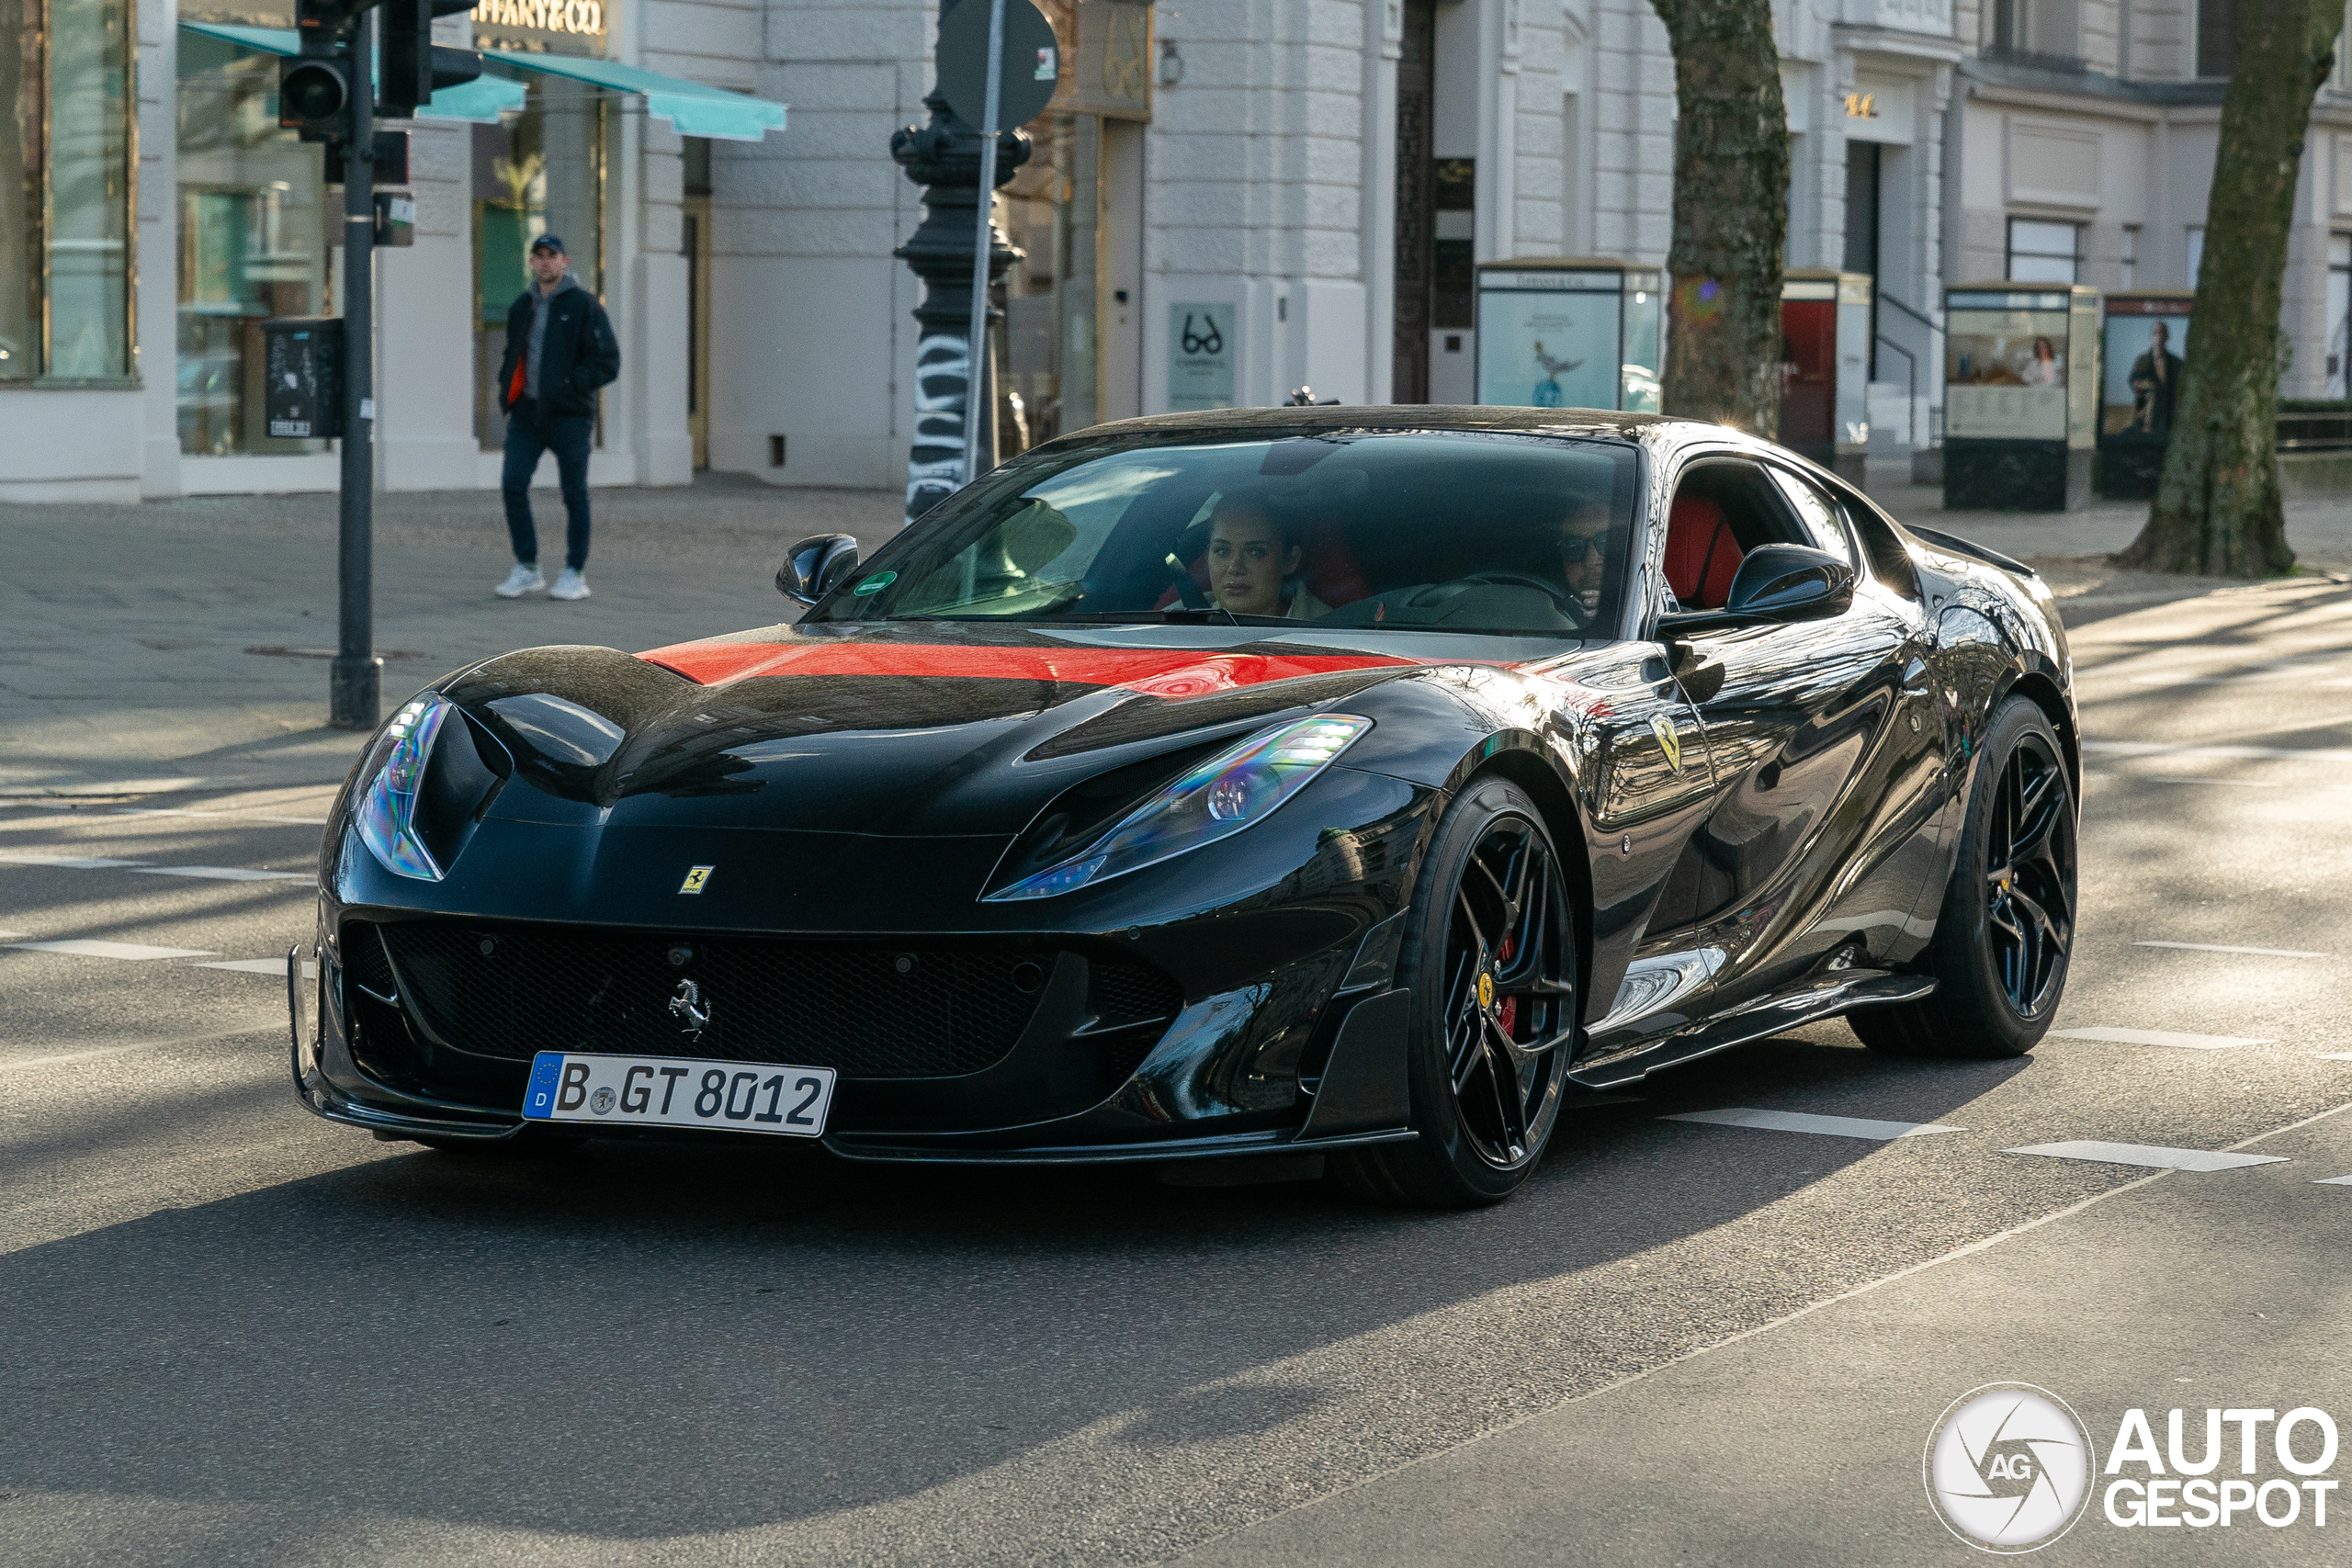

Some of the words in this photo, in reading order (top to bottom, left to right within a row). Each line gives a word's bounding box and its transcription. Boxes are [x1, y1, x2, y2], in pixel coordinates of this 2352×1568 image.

[535, 1092, 548, 1107] D
[556, 1063, 591, 1111] B
[620, 1065, 690, 1115] GT
[694, 1068, 822, 1126] 8012
